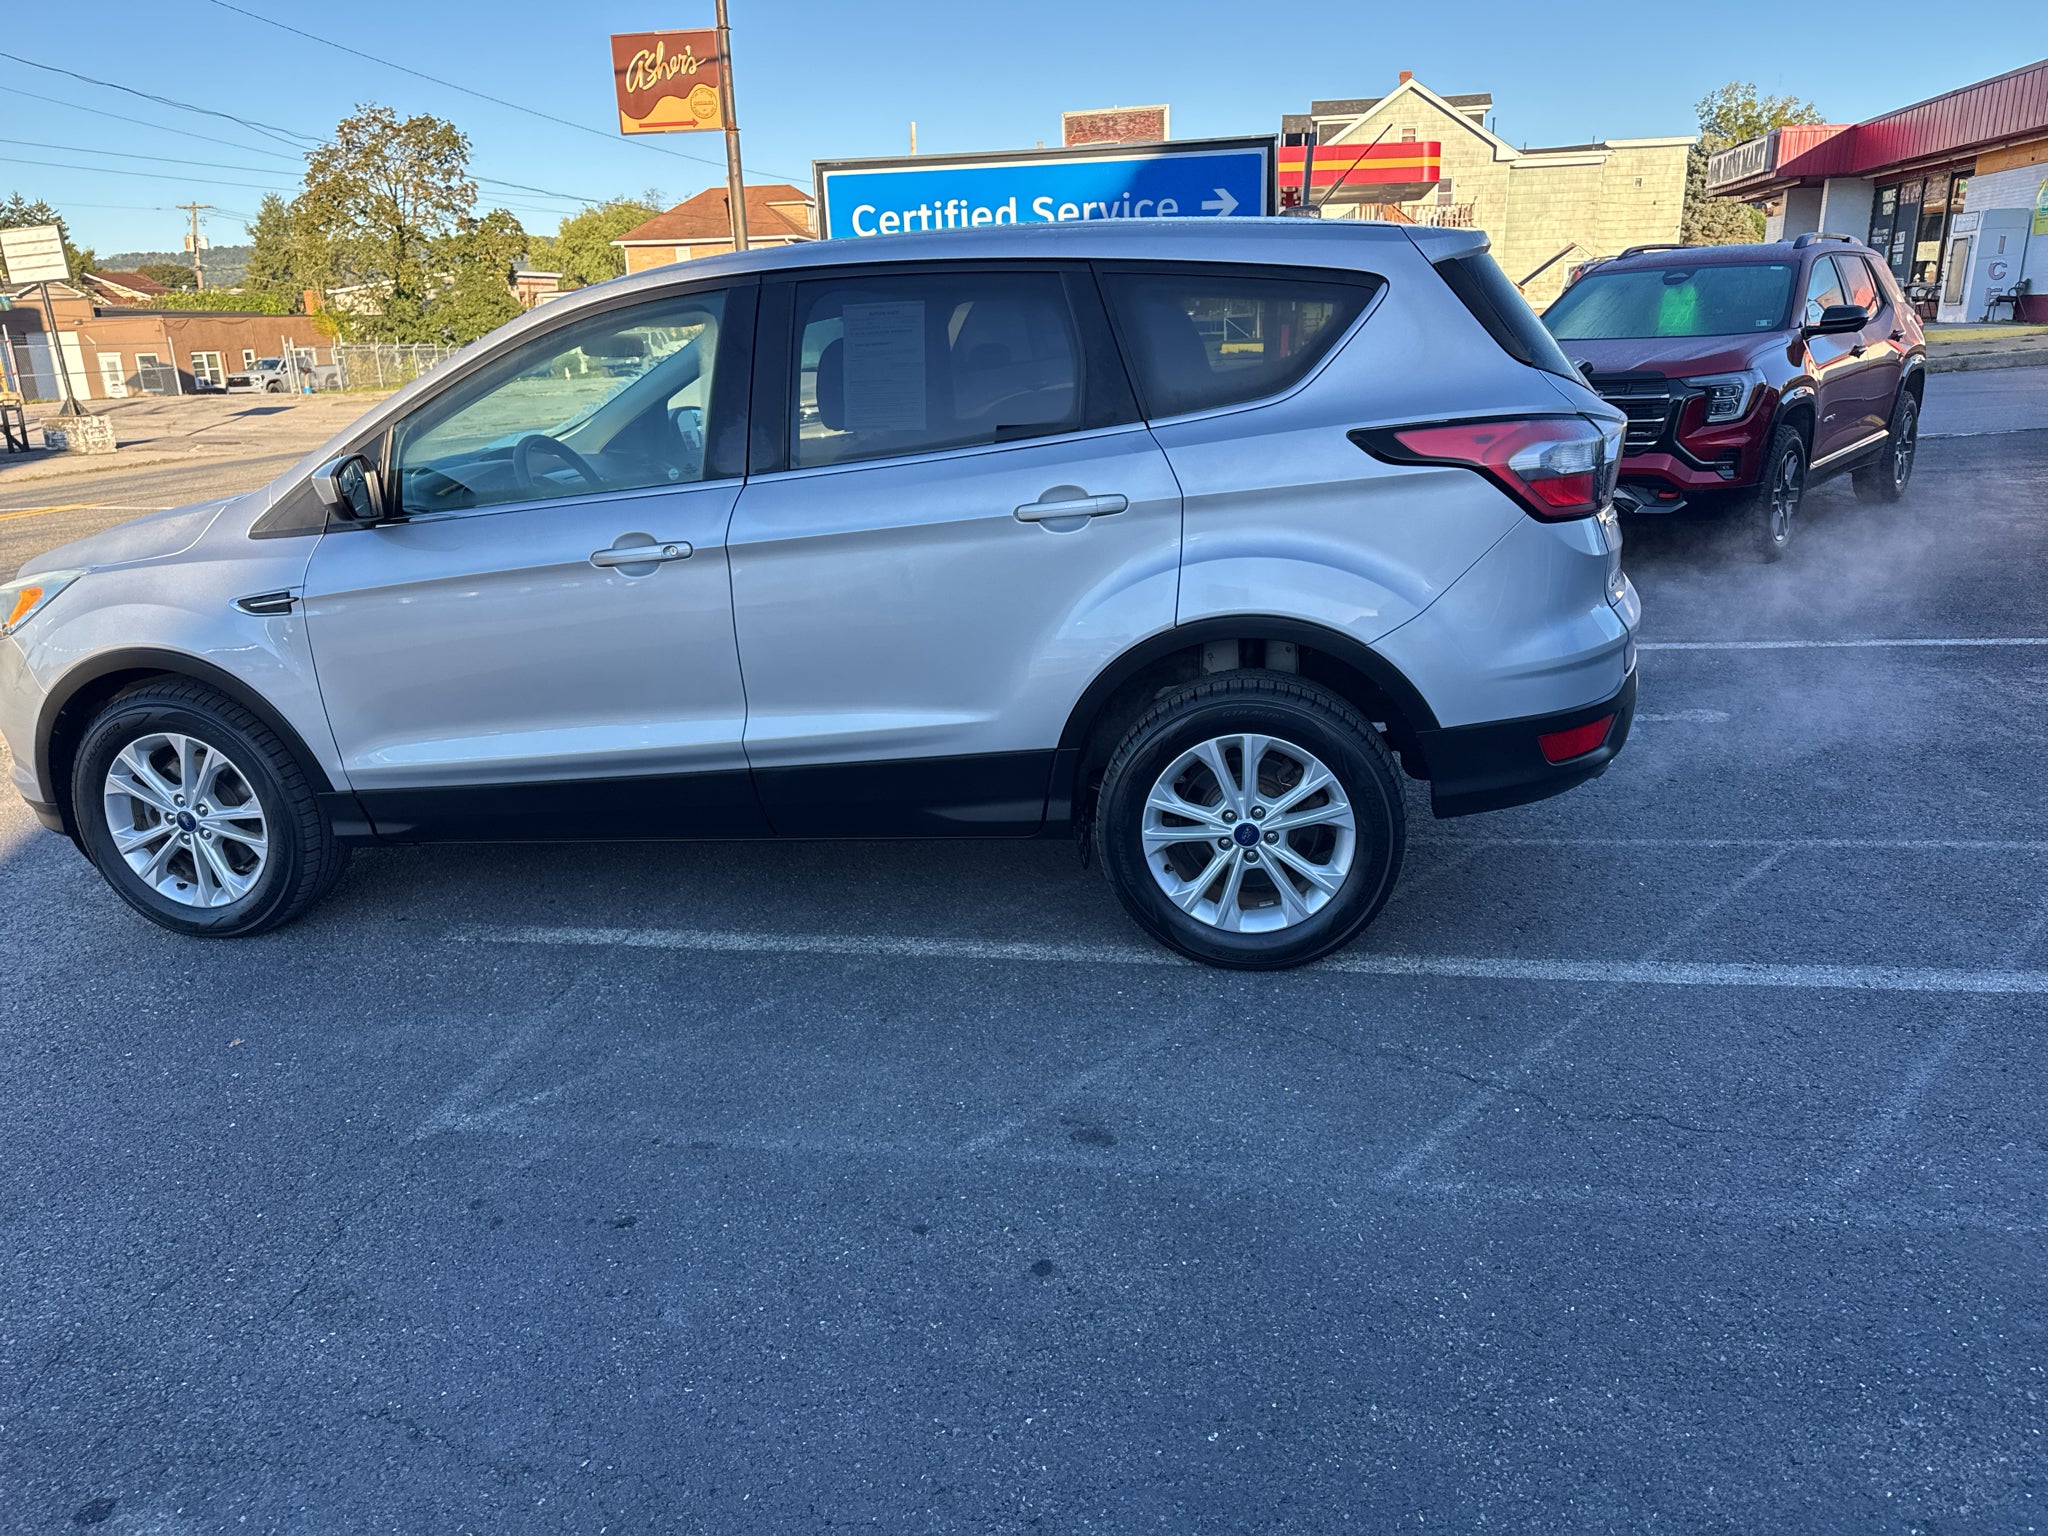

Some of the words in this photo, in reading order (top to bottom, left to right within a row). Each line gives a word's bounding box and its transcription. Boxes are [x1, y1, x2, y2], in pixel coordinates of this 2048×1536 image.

[852, 197, 1017, 237] Certified
[1032, 191, 1179, 222] Service
[1984, 235, 2008, 306] ICE
